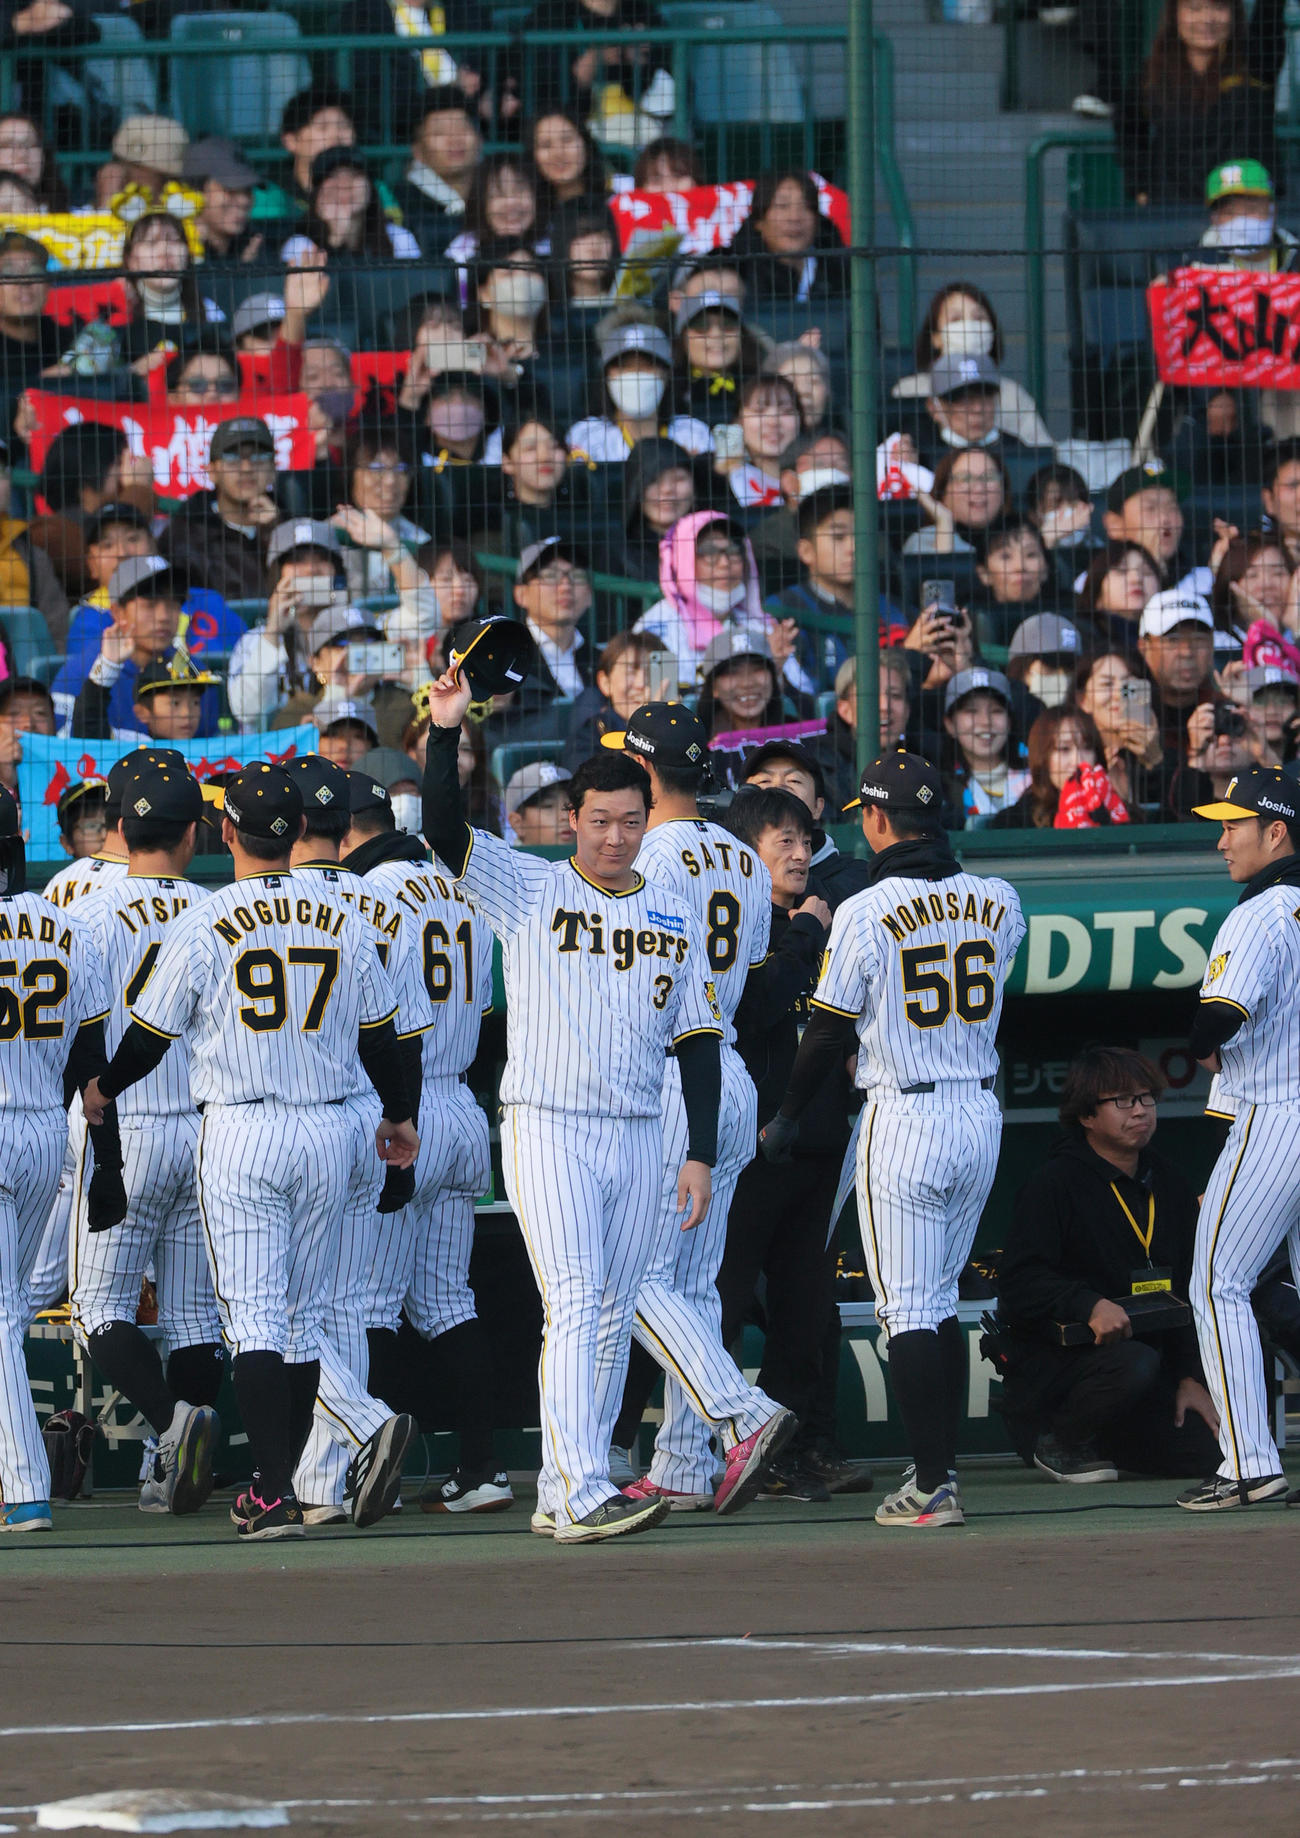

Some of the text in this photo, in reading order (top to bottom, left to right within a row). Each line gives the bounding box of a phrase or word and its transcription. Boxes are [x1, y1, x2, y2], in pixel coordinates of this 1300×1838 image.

[1185, 285, 1300, 363] 大山
[626, 730, 656, 754] Joshin
[860, 783, 889, 800] Joshin
[1257, 796, 1296, 818] Joshin
[681, 842, 753, 879] SATO
[213, 897, 347, 947] NOGUCHI
[551, 907, 689, 971] Tigers
[649, 911, 684, 930] Joshin
[706, 889, 741, 974] 8
[881, 892, 1006, 943] MOMOSAKI
[422, 919, 474, 1004] 61
[1004, 906, 1210, 994] DTS
[234, 946, 341, 1034] 97
[652, 974, 674, 1011] 3
[900, 938, 996, 1030] 56
[97, 1322, 112, 1336] 40
